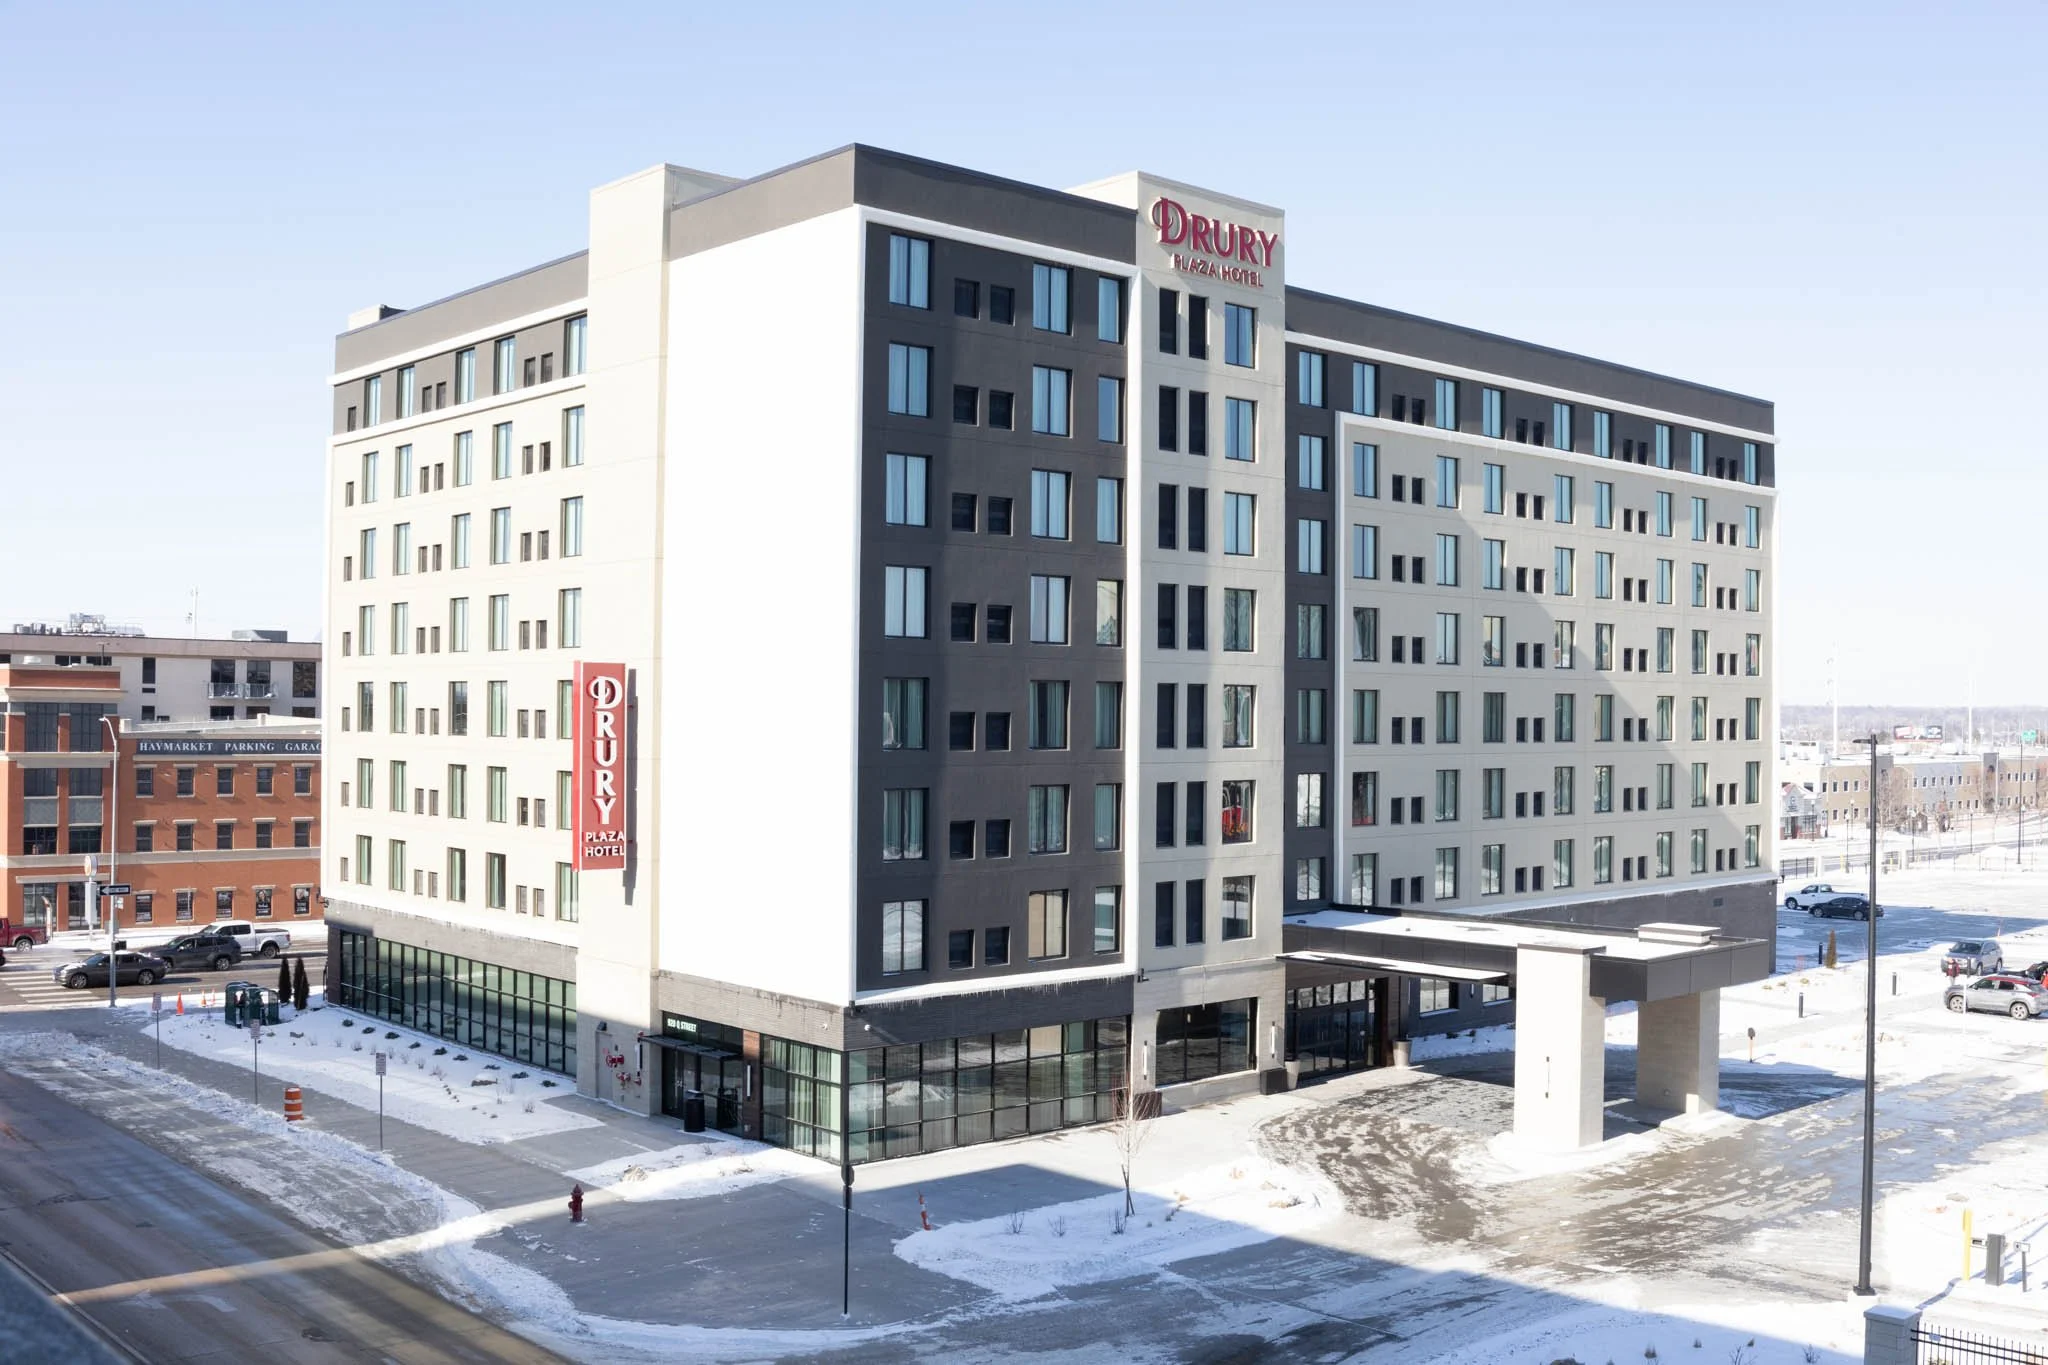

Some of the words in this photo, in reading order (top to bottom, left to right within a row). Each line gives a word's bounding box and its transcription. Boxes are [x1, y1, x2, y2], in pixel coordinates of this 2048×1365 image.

[1151, 197, 1278, 268] DRURY
[1172, 253, 1217, 278] PLAZA
[1220, 265, 1264, 288] HOTEL
[139, 742, 213, 751] HAYMARKET
[225, 742, 275, 751] PARKING
[587, 675, 623, 825] DRURY
[585, 831, 625, 843] PLAZA
[585, 846, 625, 857] HOTEL
